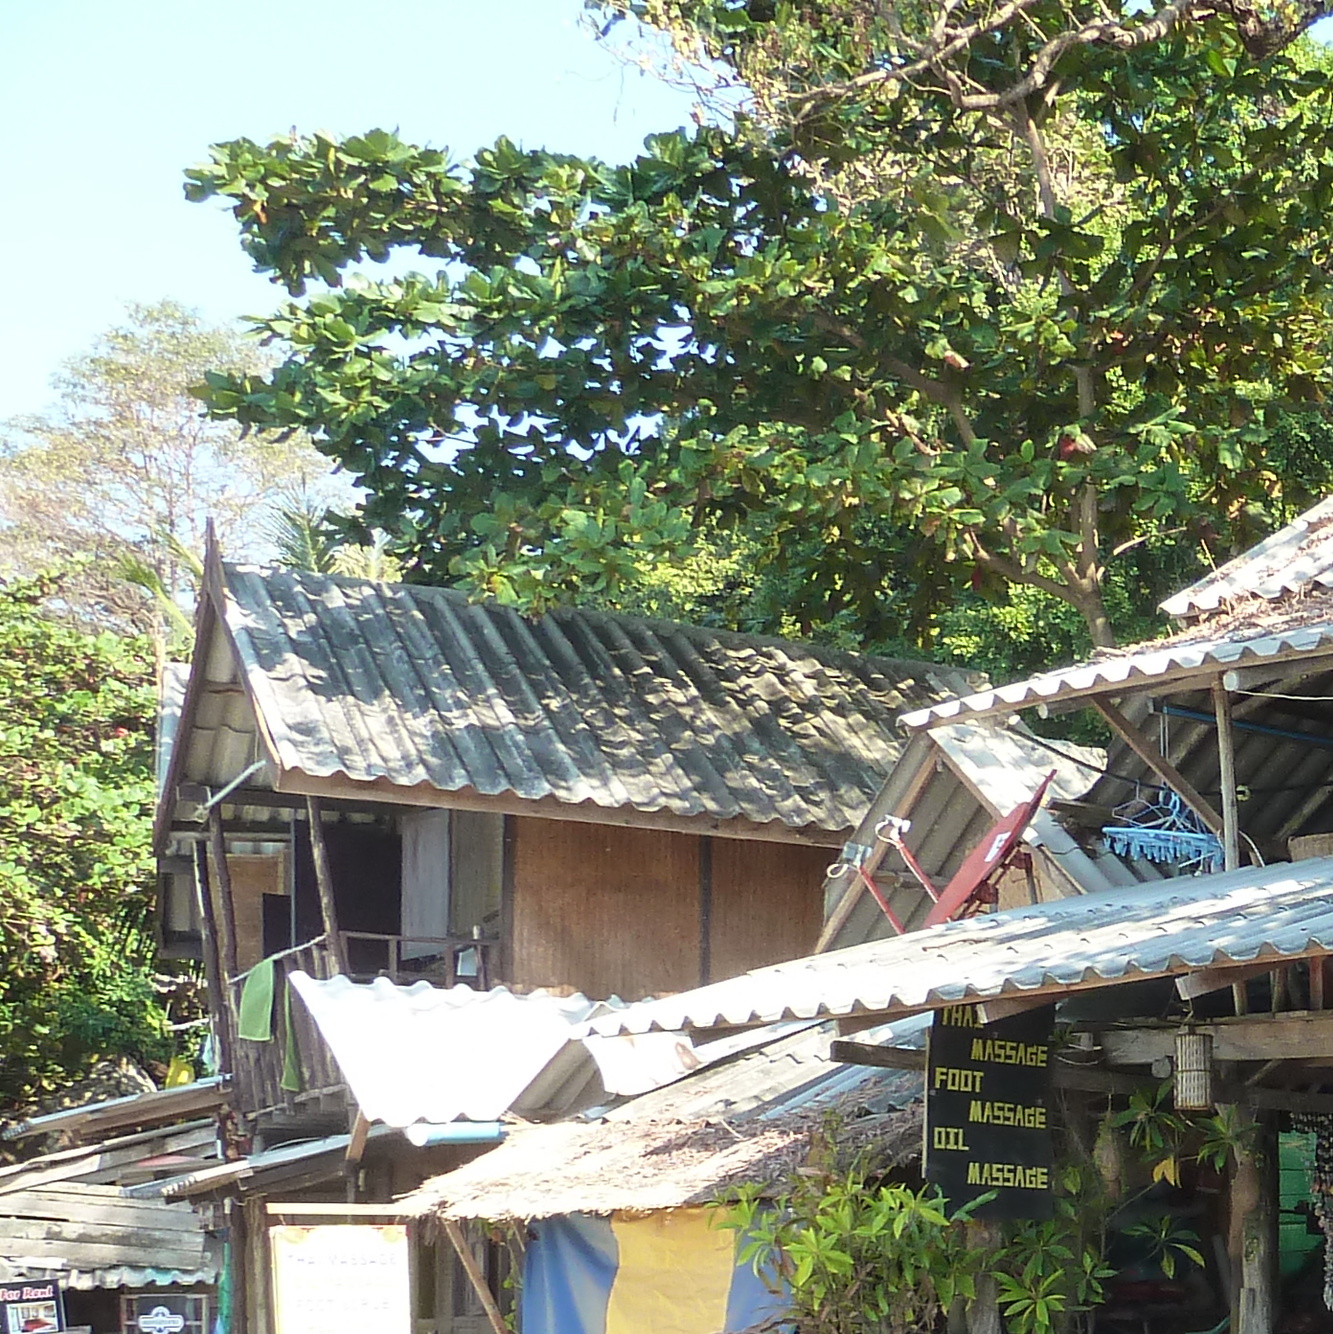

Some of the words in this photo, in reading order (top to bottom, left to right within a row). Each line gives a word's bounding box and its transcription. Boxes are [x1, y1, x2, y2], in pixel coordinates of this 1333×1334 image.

[942, 1004, 984, 1029] THA
[970, 1037, 1049, 1068] MASSAGE
[934, 1066, 985, 1093] FOOT
[968, 1099, 1047, 1129] MASSAGE
[933, 1126, 970, 1151] OIL
[966, 1161, 1049, 1190] MASSAGE
[22, 1285, 53, 1299] Rent
